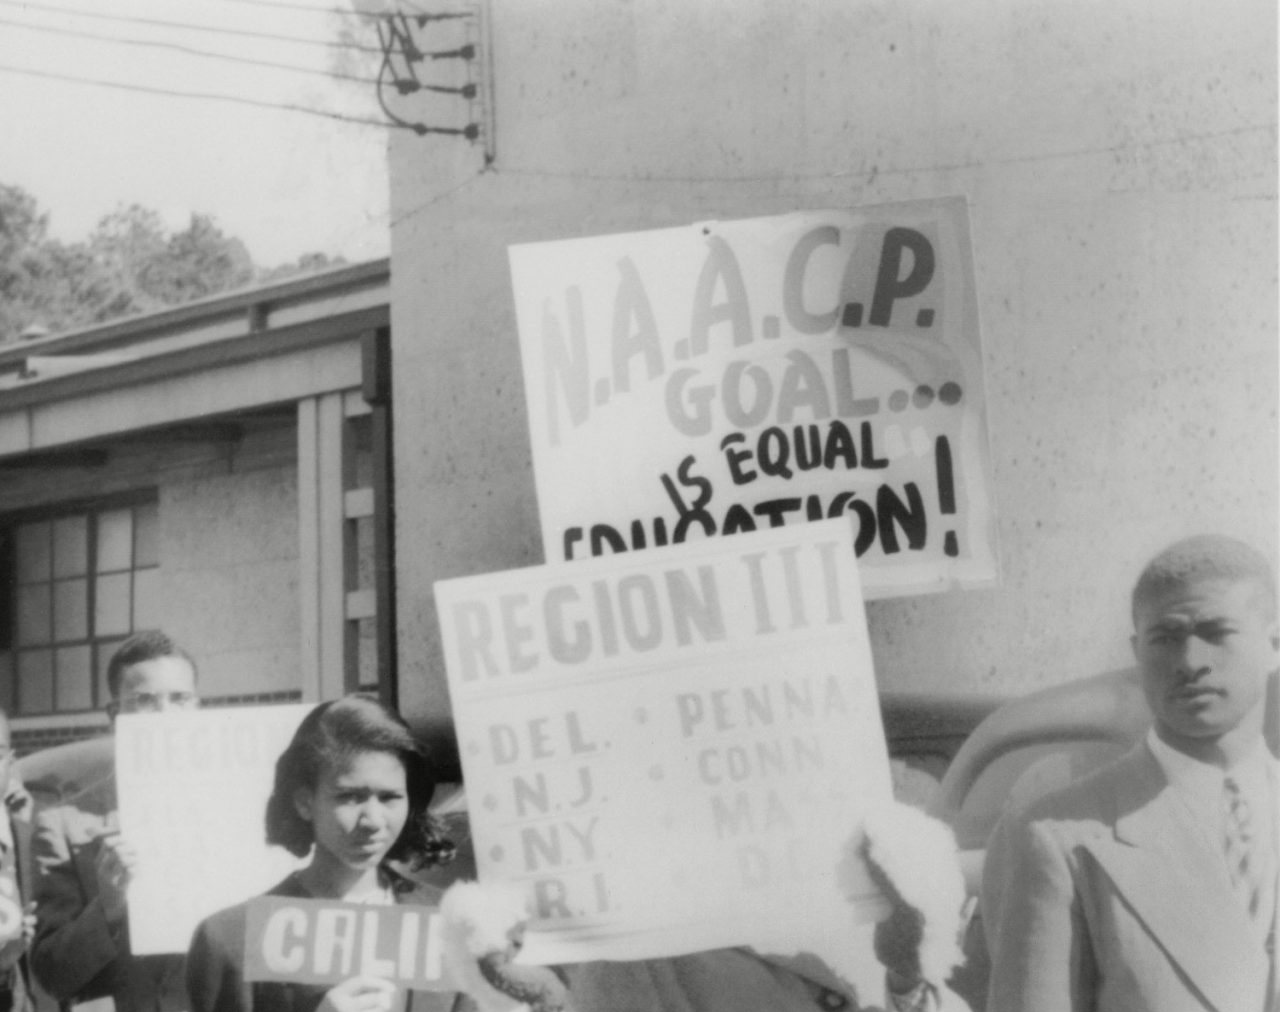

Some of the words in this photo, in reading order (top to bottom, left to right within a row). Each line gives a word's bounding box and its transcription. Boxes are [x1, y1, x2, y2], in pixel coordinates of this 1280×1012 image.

[539, 224, 938, 450] N.A.A.C.P.
[658, 454, 713, 516] IS
[721, 420, 890, 486] EQUAL
[452, 564, 727, 683] REGION
[741, 541, 845, 638] III
[487, 710, 612, 767] DEL.
[513, 766, 608, 819] N.J.
